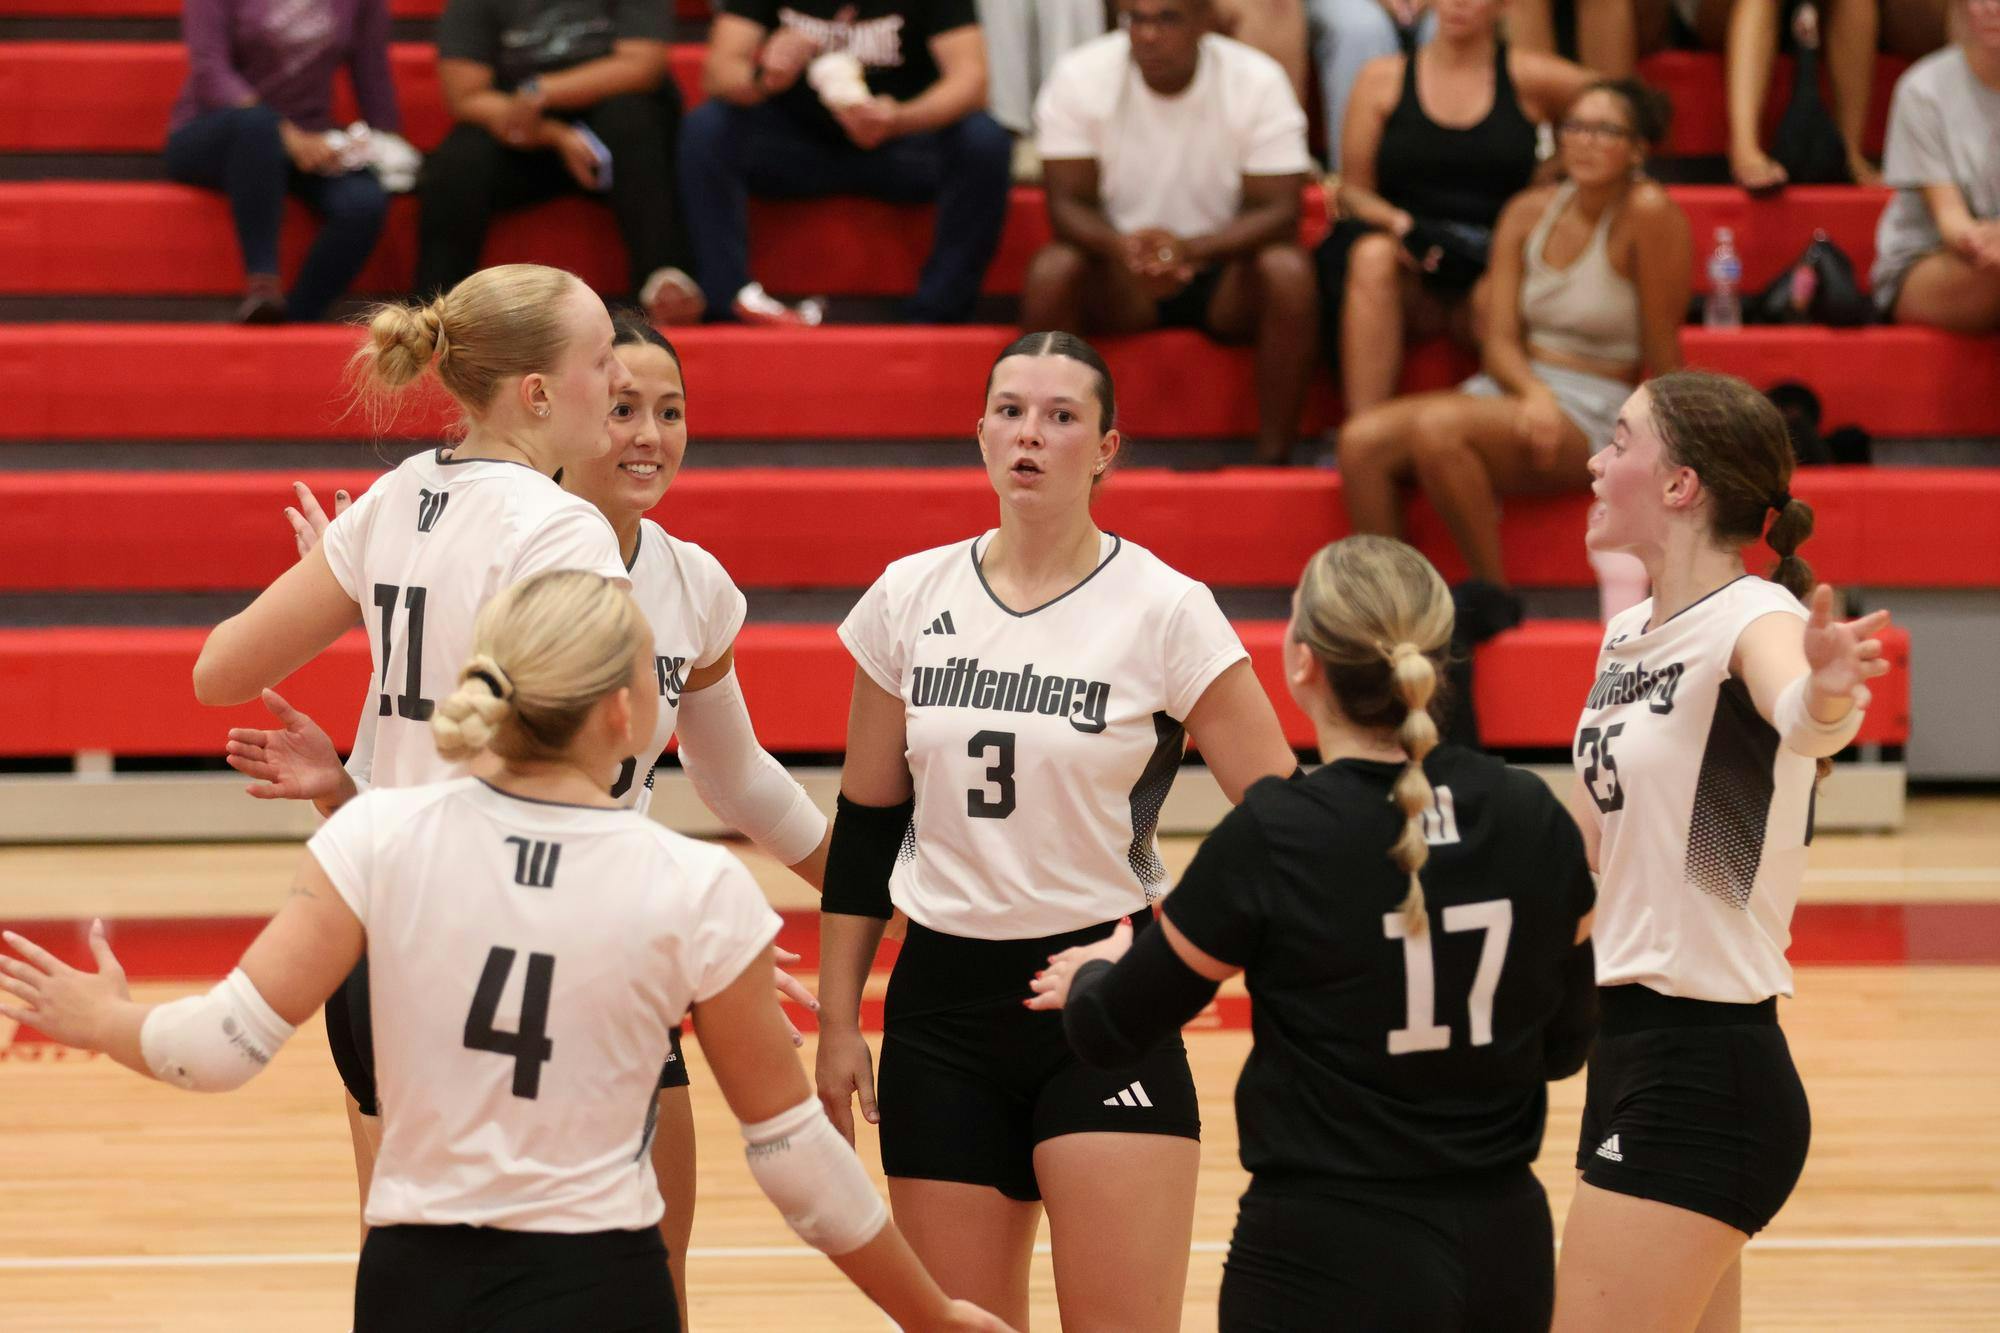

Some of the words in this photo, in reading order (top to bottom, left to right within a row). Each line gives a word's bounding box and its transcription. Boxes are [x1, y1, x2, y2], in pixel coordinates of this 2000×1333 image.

[374, 583, 435, 721] 11
[967, 730, 1016, 819] 3
[1578, 722, 1625, 814] 25
[463, 946, 555, 1100] 4
[1383, 899, 1512, 1055] 17
